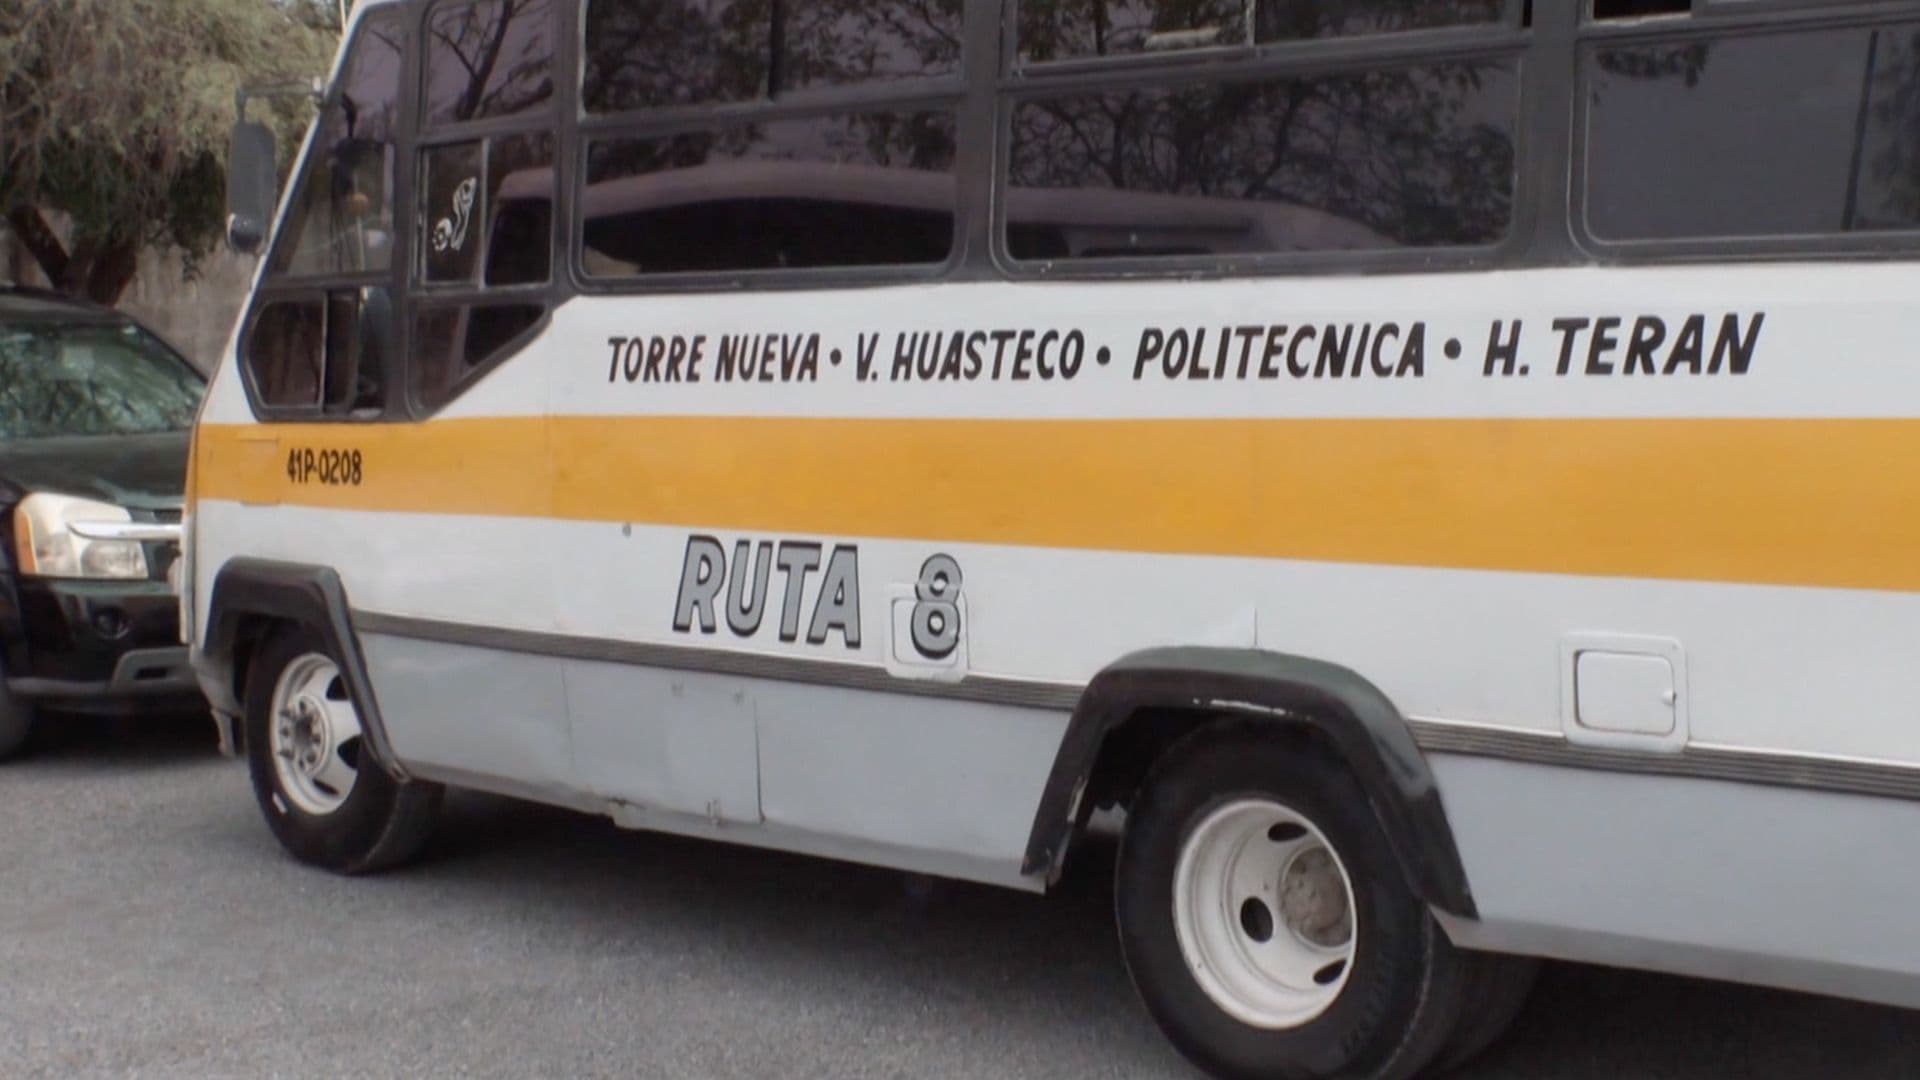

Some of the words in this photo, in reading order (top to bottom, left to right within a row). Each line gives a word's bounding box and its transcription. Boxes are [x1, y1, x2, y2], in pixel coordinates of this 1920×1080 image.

[607, 335, 707, 382] TORRE
[714, 333, 821, 382] NUEVA
[856, 332, 880, 382] V.
[890, 328, 1085, 382] HUASTECO
[1132, 322, 1426, 380] POLITECNICA
[1482, 319, 1530, 377] H.
[1551, 311, 1766, 376] TERAN
[287, 447, 363, 486] 41P-0208
[672, 534, 862, 649] RUTA
[910, 552, 963, 660] 8
